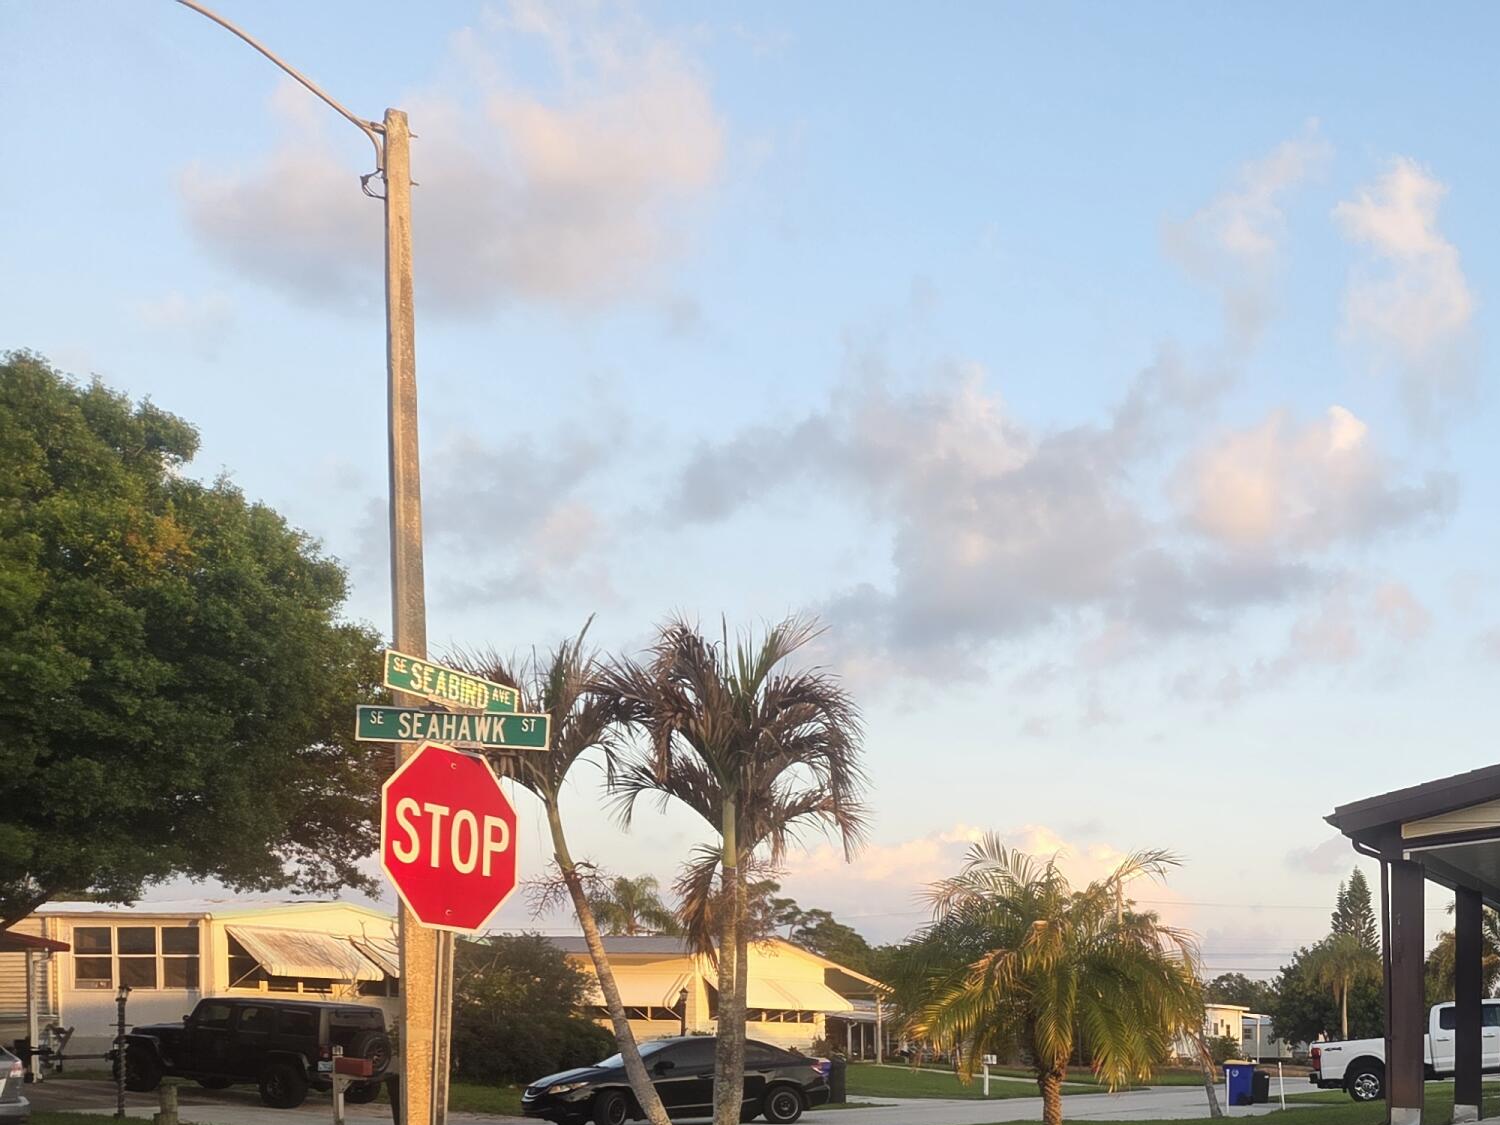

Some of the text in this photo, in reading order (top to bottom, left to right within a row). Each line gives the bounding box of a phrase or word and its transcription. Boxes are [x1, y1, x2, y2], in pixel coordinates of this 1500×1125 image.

[393, 656, 512, 709] SE SEABIRD AVE
[370, 711, 536, 743] SE SEAHAWK ST
[392, 797, 510, 877] STOP
